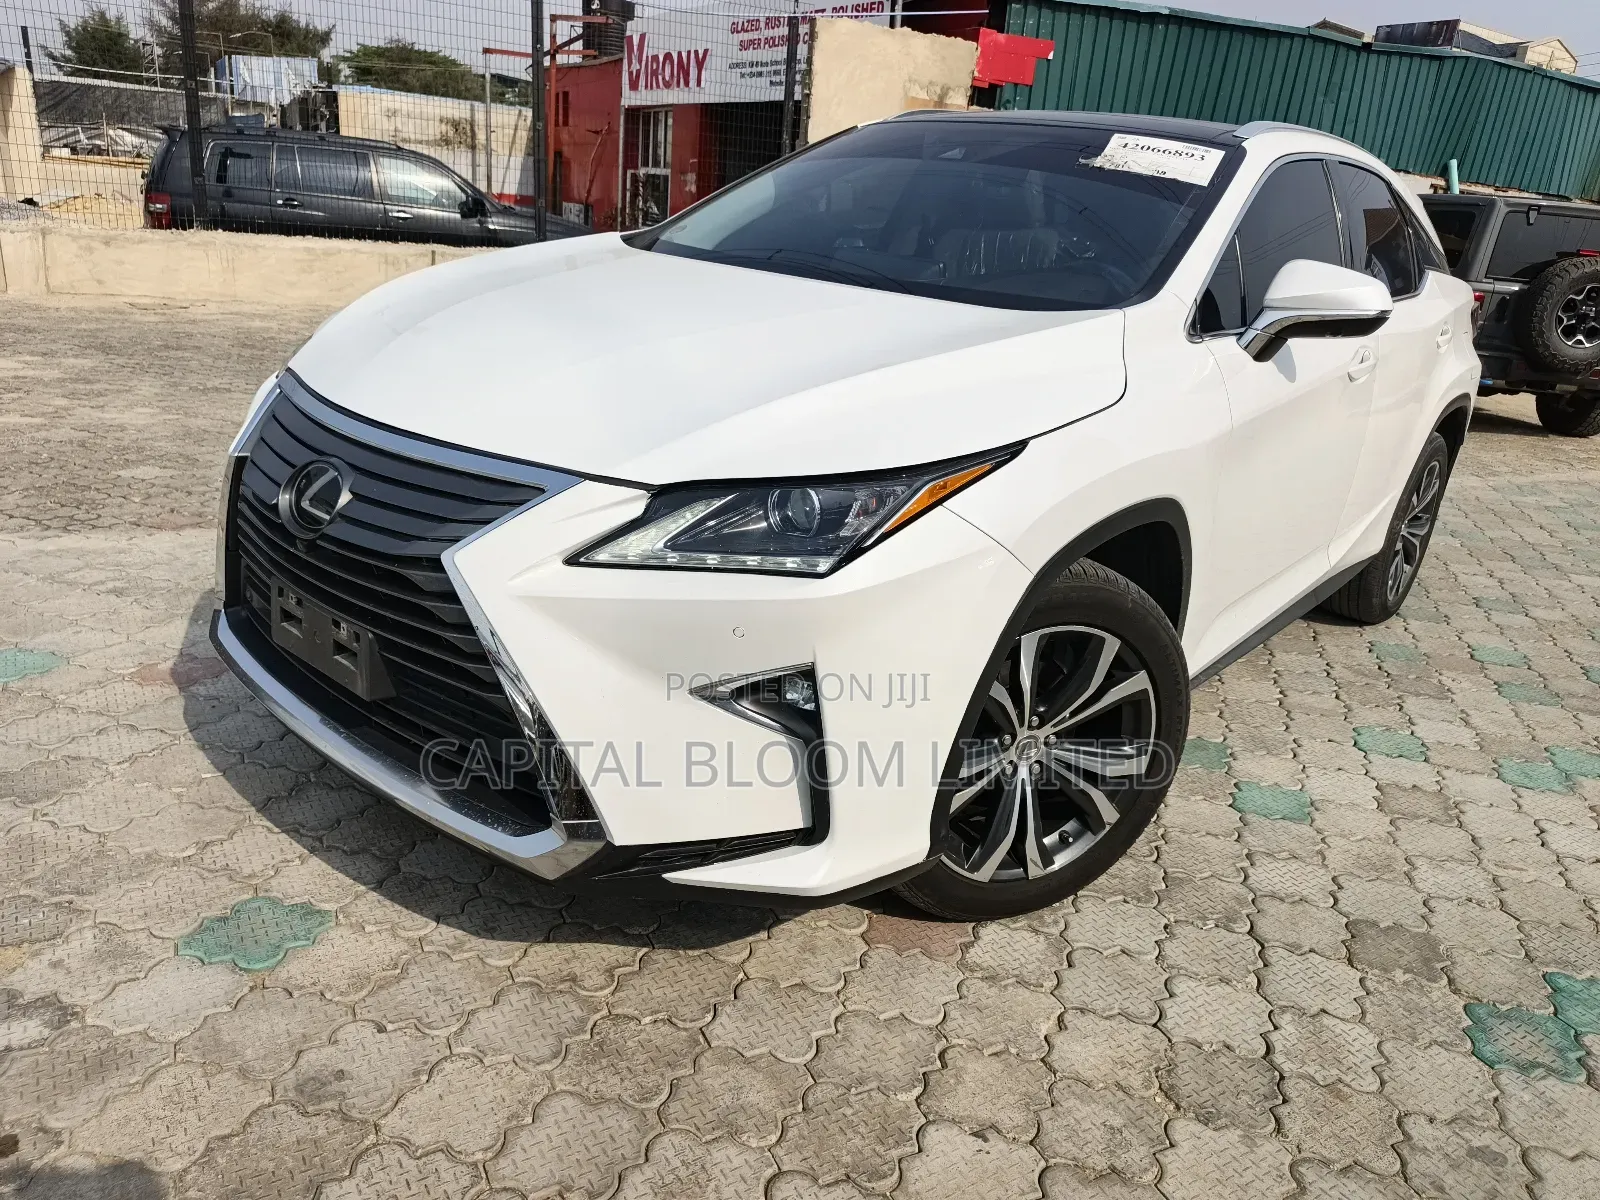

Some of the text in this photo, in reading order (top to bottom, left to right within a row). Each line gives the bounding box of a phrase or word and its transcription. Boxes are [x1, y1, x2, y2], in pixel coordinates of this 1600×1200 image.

[730, 18, 763, 35] GLAZED,
[831, 1, 885, 19] POLISHED
[739, 38, 762, 51] SUPER
[764, 32, 801, 49] POLISHD
[626, 33, 710, 92] VIRONY
[1118, 142, 1206, 161] 42066893
